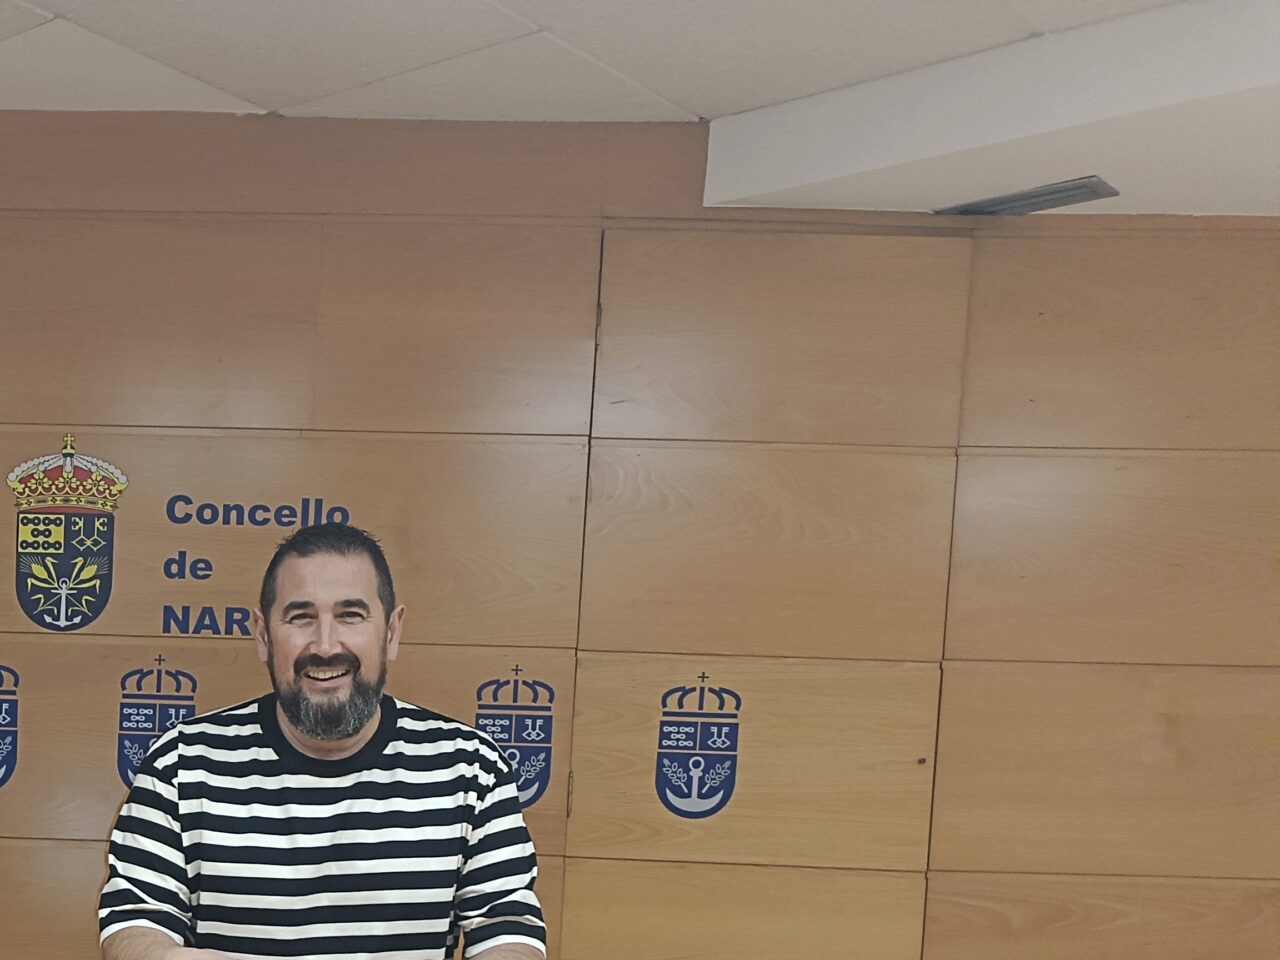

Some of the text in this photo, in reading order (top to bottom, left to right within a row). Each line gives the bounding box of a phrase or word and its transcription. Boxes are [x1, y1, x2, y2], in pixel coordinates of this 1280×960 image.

[166, 494, 350, 528] Concello
[163, 550, 213, 580] de
[161, 604, 252, 636] NAR
